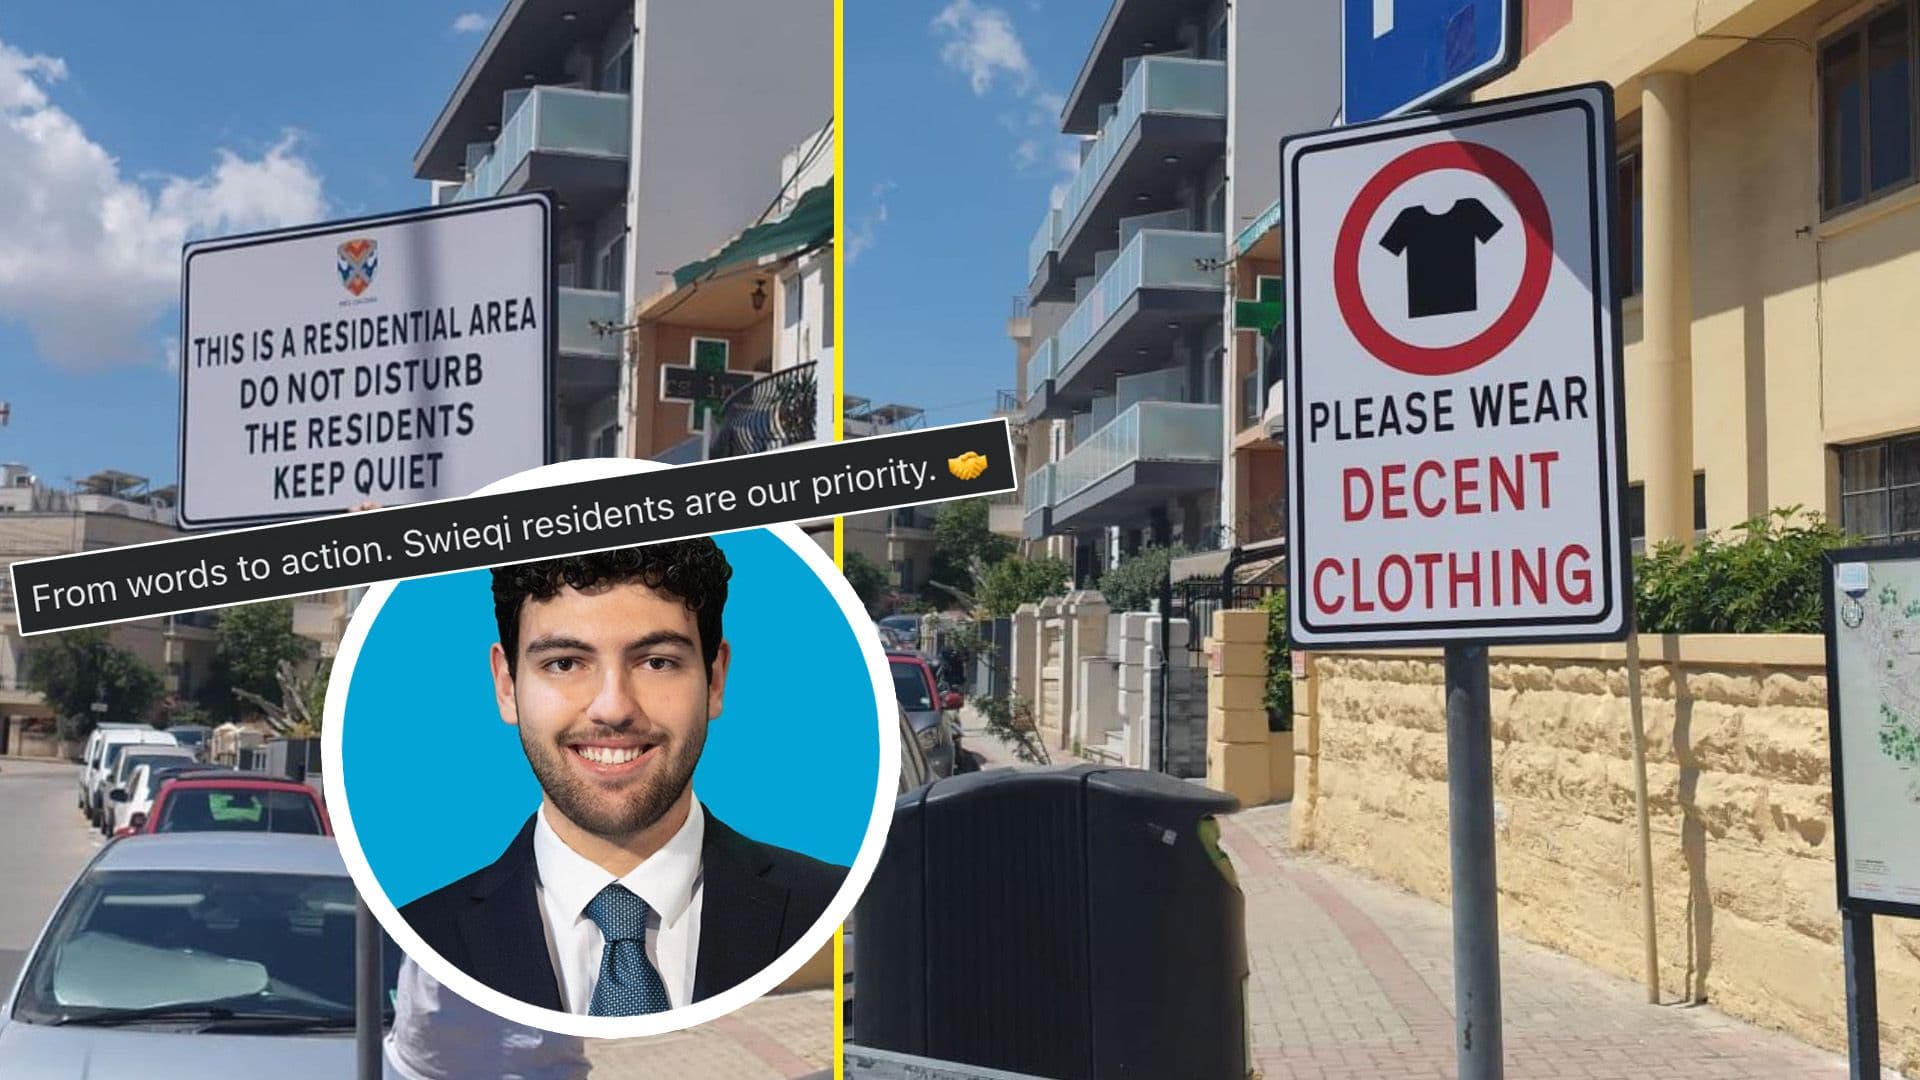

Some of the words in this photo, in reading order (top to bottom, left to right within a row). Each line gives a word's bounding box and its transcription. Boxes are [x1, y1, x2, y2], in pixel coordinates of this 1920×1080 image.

[194, 333, 243, 368] THIS
[253, 330, 273, 360] IS
[282, 328, 295, 358] A
[305, 307, 461, 355] RESIDENTIAL
[470, 297, 537, 335] AREA
[241, 376, 278, 409] DO
[289, 368, 344, 404] NOT
[355, 353, 482, 397] DISTURB
[1311, 389, 1454, 442] PLEASE
[1470, 376, 1588, 428] WEAR
[245, 420, 296, 454] THE
[309, 402, 474, 448] RESIDENTS
[275, 462, 344, 499] KEEP
[355, 452, 443, 494] QUIET
[1343, 451, 1558, 521] DECENT
[1313, 544, 1592, 614] CLOTHING
